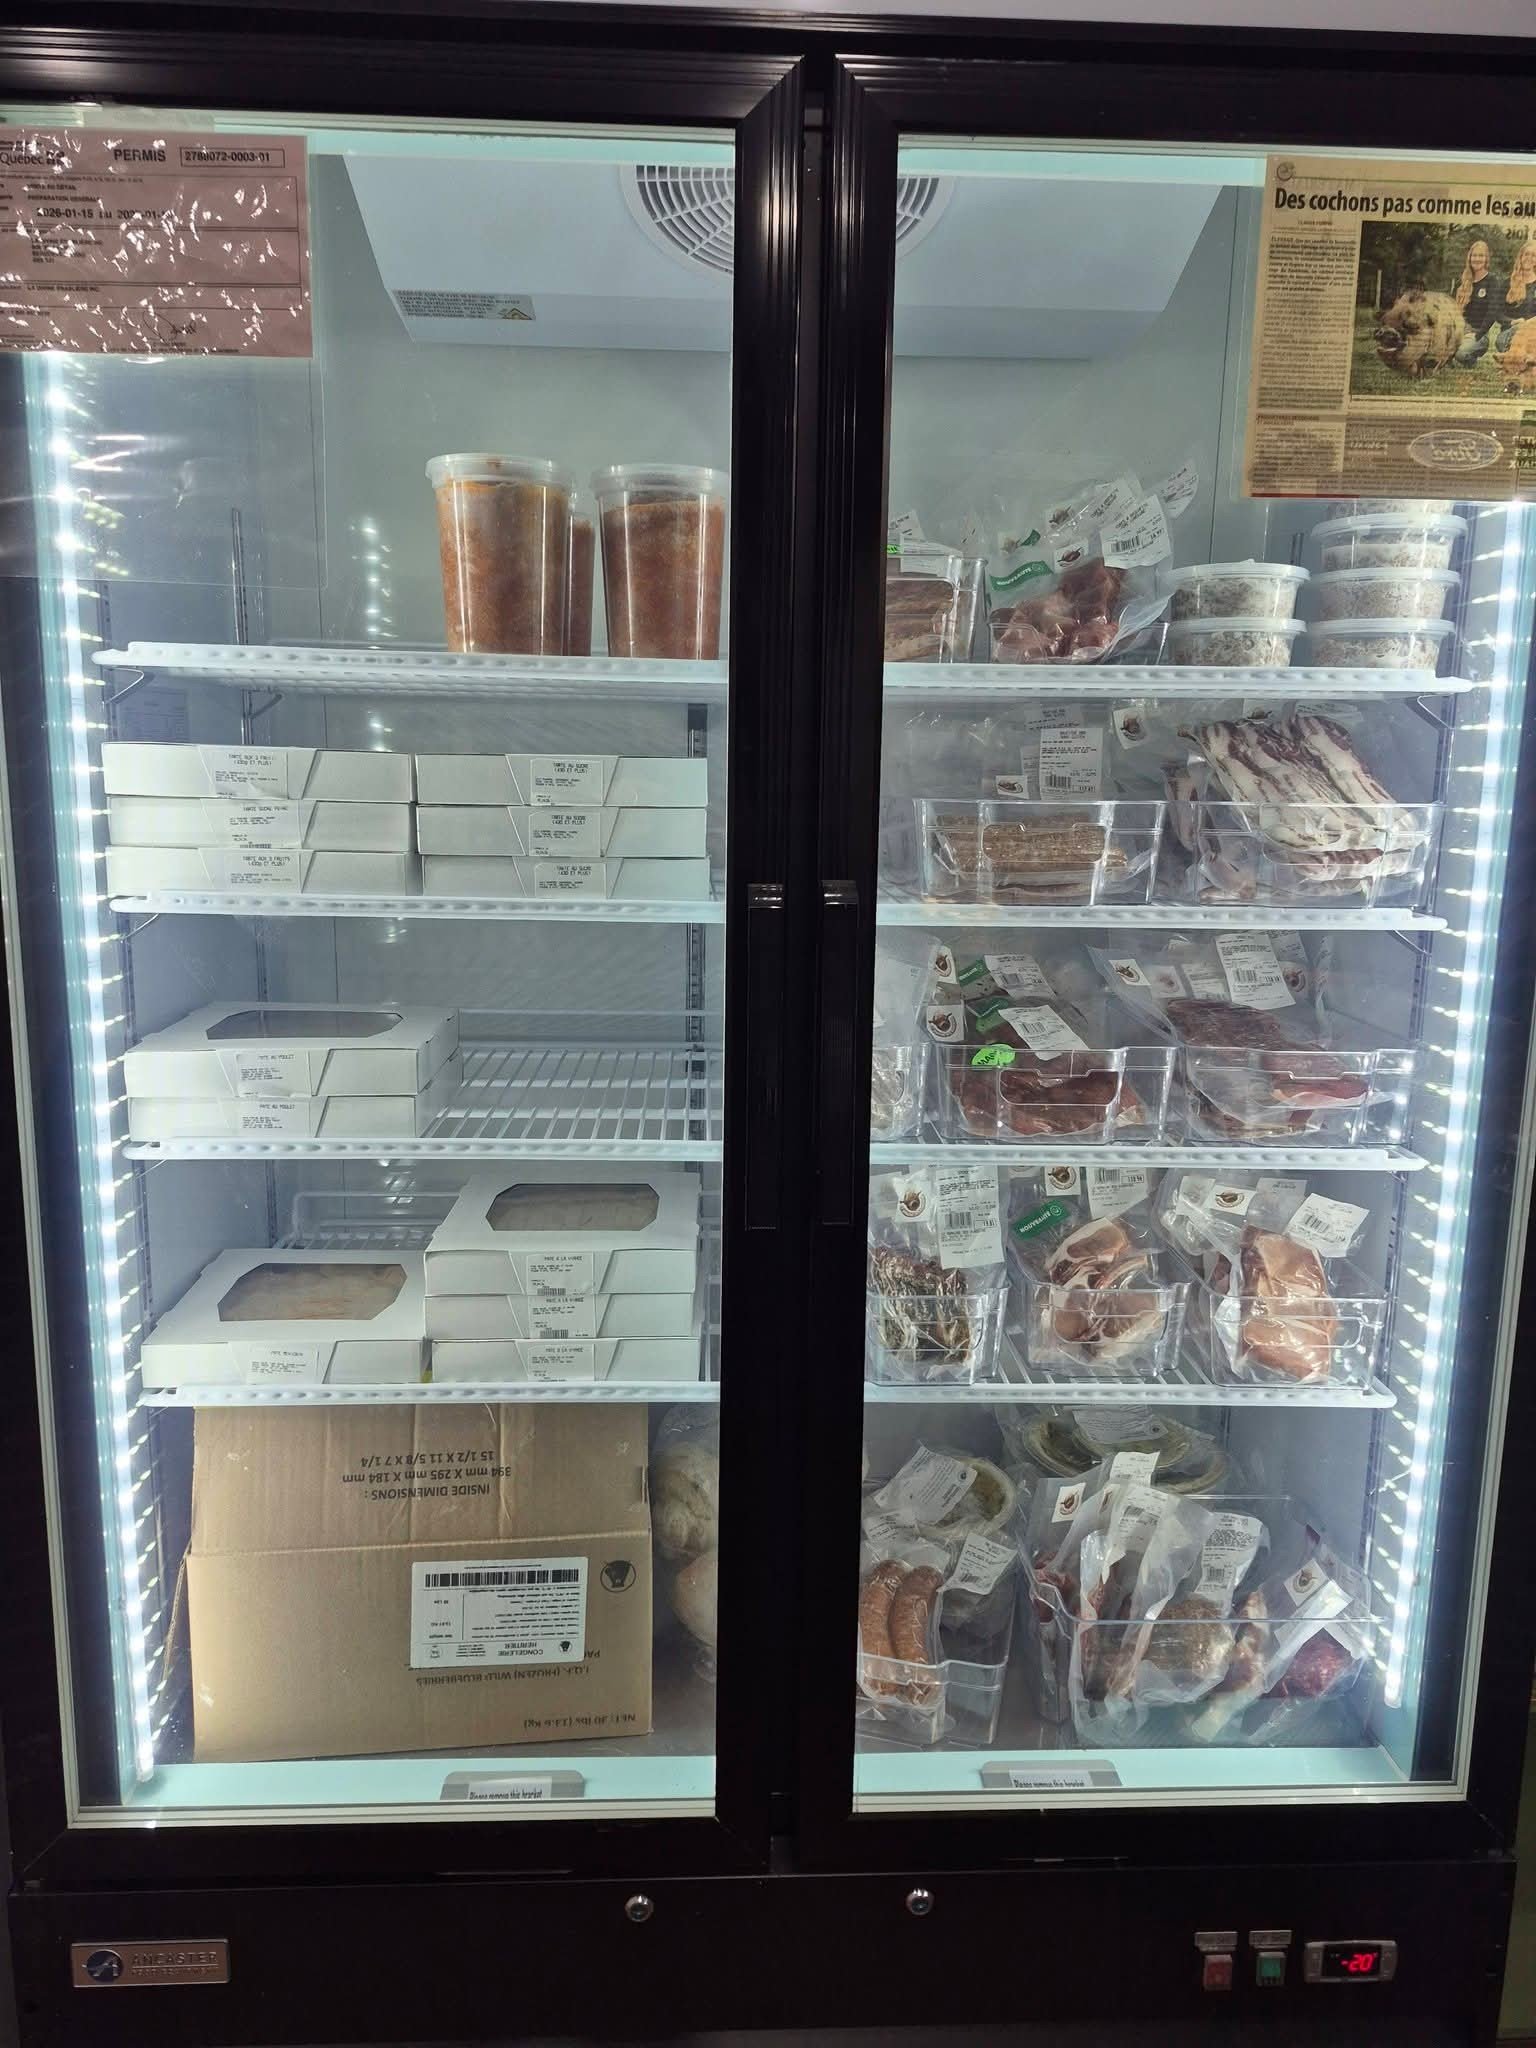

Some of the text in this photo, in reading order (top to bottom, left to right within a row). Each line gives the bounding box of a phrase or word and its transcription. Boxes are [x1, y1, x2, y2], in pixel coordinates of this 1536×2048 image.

[113, 148, 167, 162] PERMIS
[1275, 187, 1305, 210] Des
[1309, 190, 1379, 212] cochons
[1382, 197, 1413, 219] pas
[1417, 197, 1482, 215] comme
[1485, 194, 1510, 217] les
[361, 1450, 495, 1468] 15 1/2 X 11 5/8 X 7 1/4
[342, 1466, 512, 1484] 394 mm X 295 mm X 184 mm
[371, 1486, 448, 1501] DIMENSIONS
[452, 1483, 490, 1496] INSIDE
[415, 1674, 483, 1687] BLUEBERRIES
[133, 1951, 217, 1966] ANCASTER
